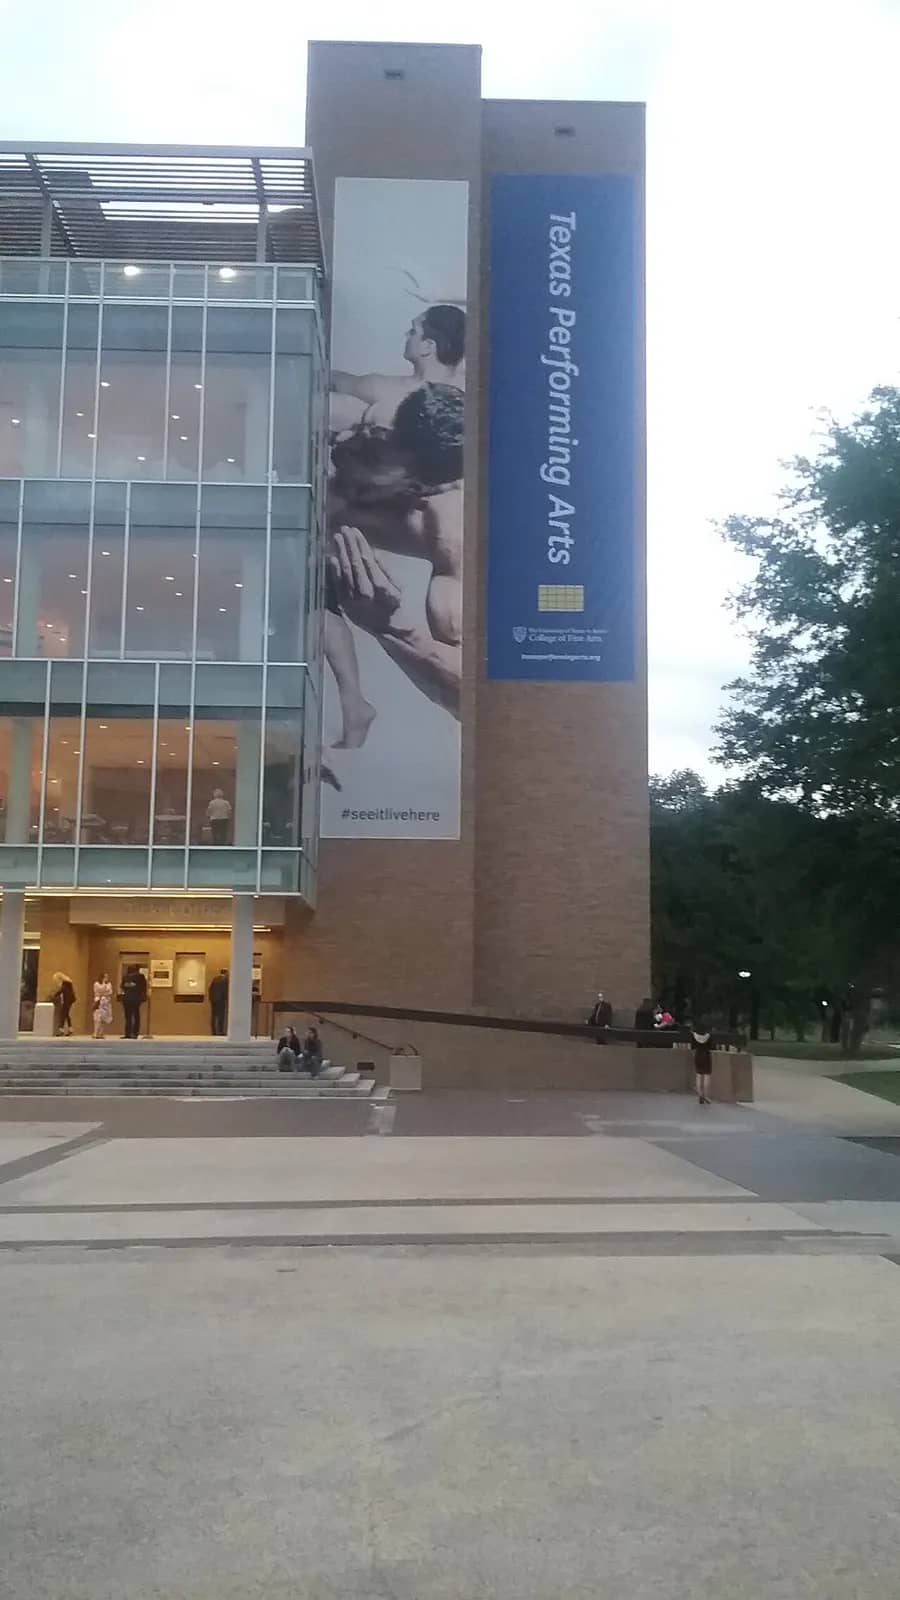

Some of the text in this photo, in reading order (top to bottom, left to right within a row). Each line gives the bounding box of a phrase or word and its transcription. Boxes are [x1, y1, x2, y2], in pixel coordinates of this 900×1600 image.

[540, 211, 579, 565] Texas Performing Arts
[529, 633, 557, 643] College
[558, 633, 567, 641] of
[341, 808, 440, 821] #seeitlivehere
